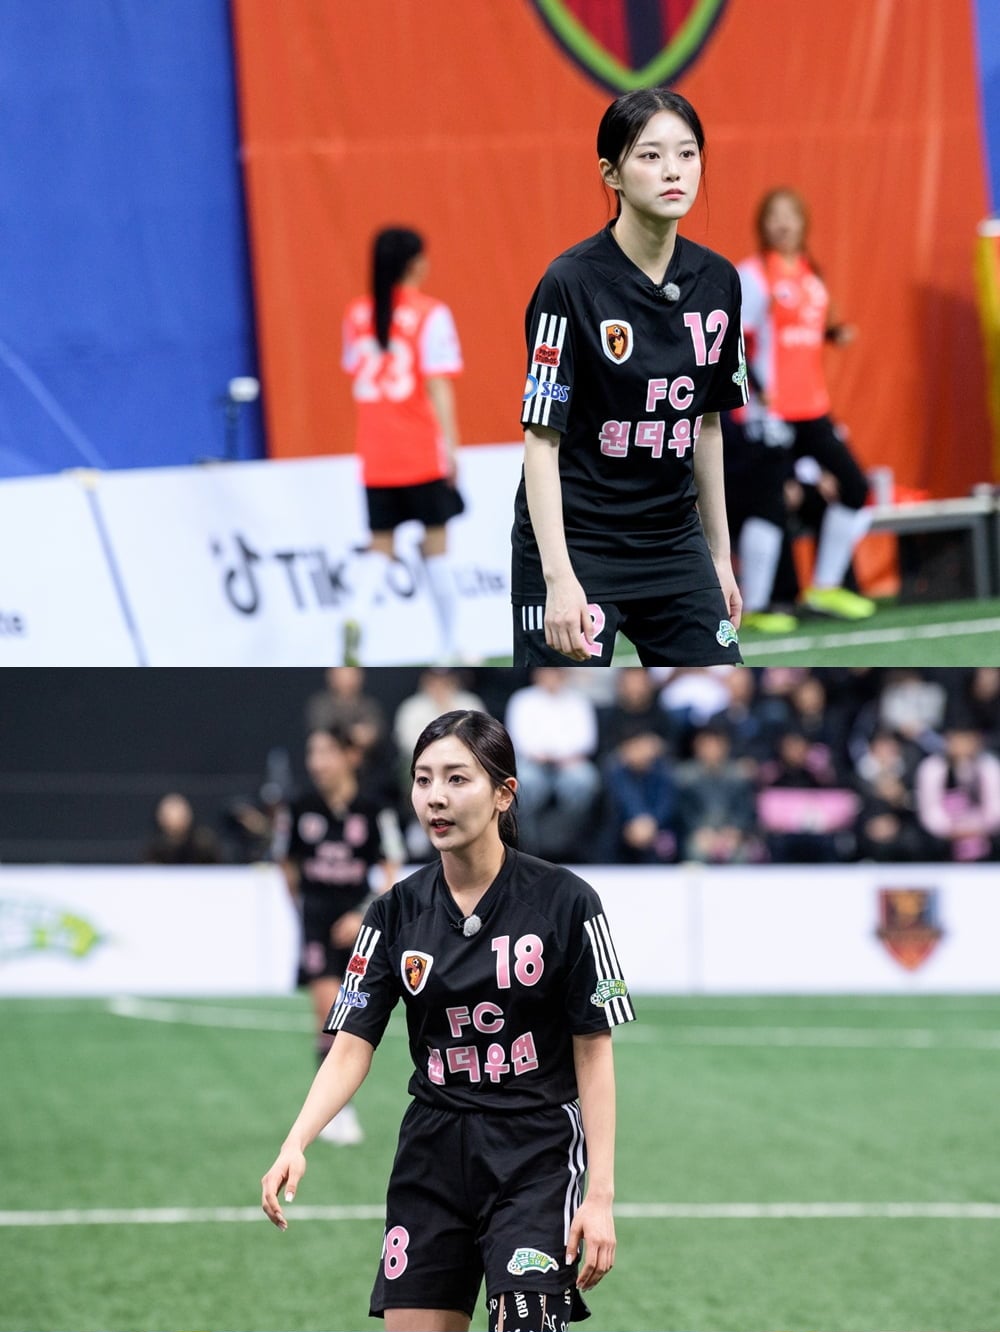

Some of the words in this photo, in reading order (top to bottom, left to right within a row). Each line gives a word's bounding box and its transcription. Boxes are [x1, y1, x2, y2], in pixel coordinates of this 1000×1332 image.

[683, 309, 729, 366] 12
[541, 381, 570, 402] SBS
[646, 376, 695, 412] FC
[599, 418, 703, 458] 원더우
[491, 934, 544, 989] 18
[446, 1002, 505, 1038] FC
[382, 1225, 410, 1280] 8
